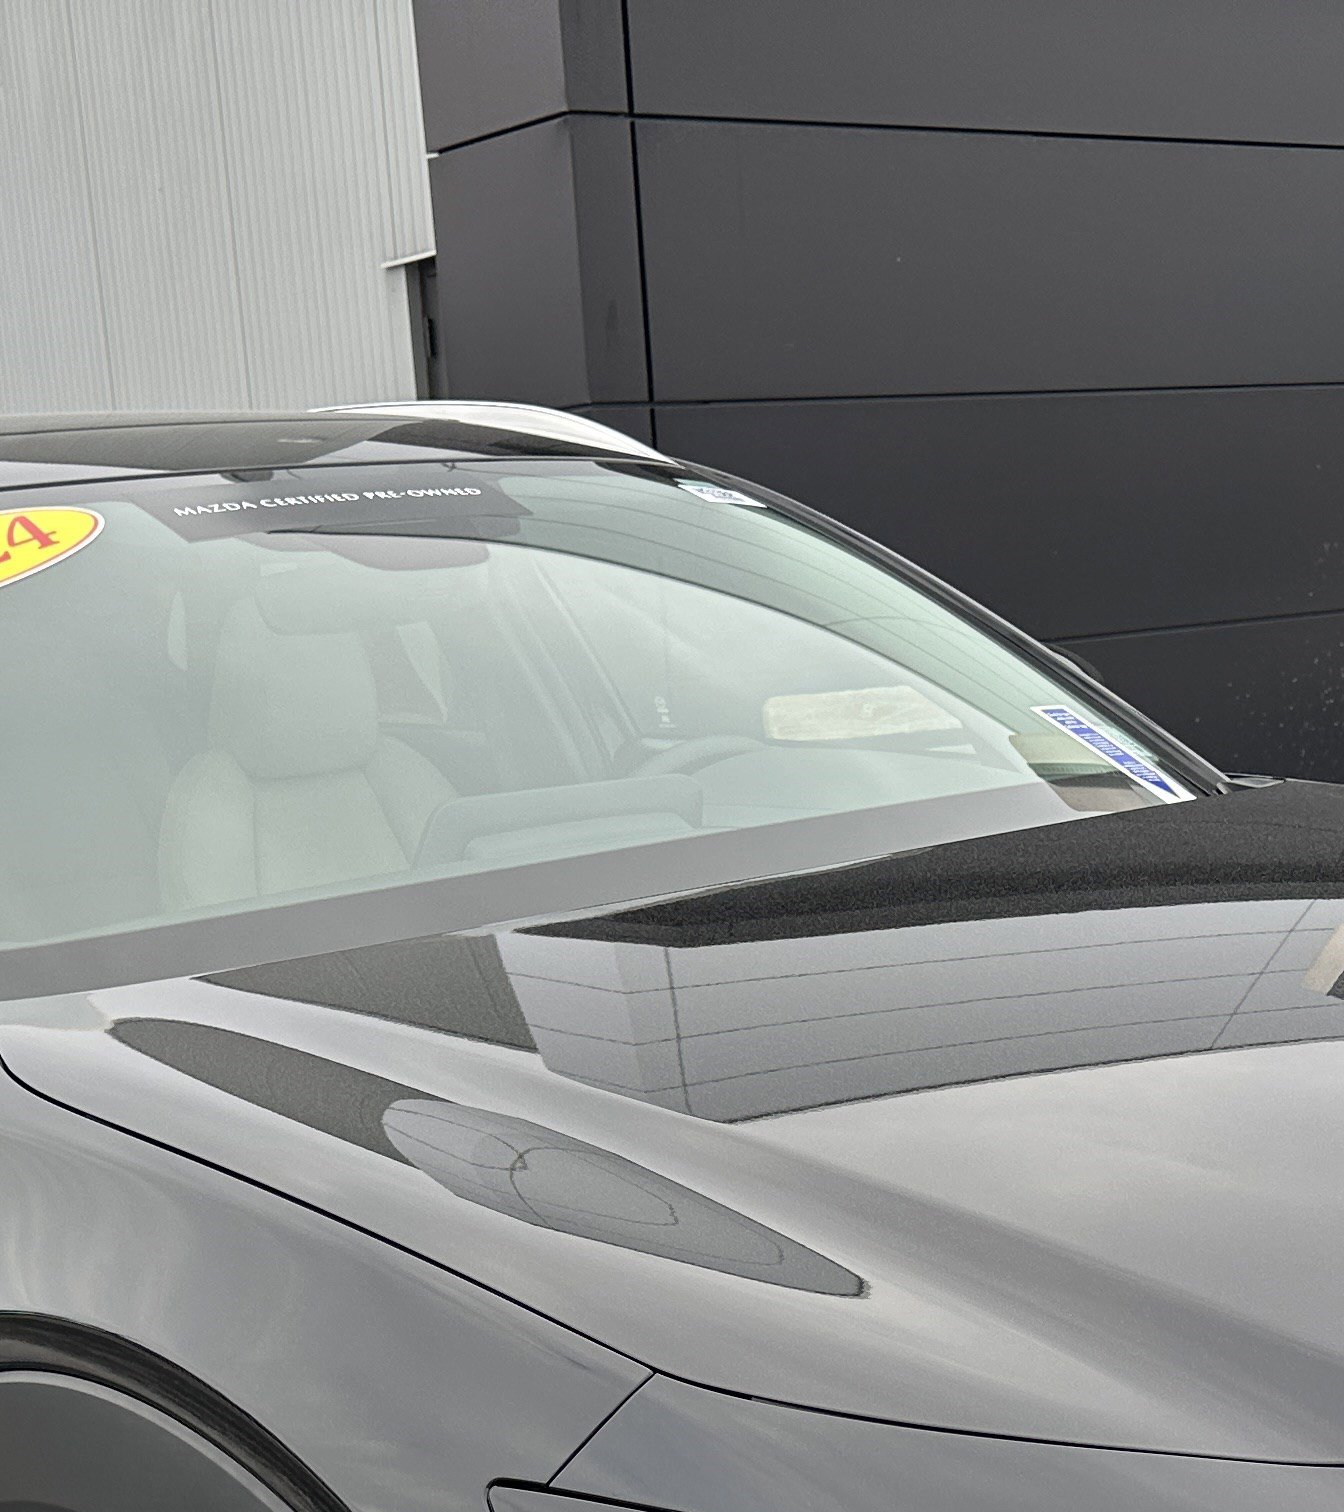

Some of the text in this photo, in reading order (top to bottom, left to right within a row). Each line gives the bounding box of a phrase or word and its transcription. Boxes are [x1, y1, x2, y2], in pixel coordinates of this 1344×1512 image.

[174, 486, 482, 518] MAZDA CERTIFIED PRE-OWNED
